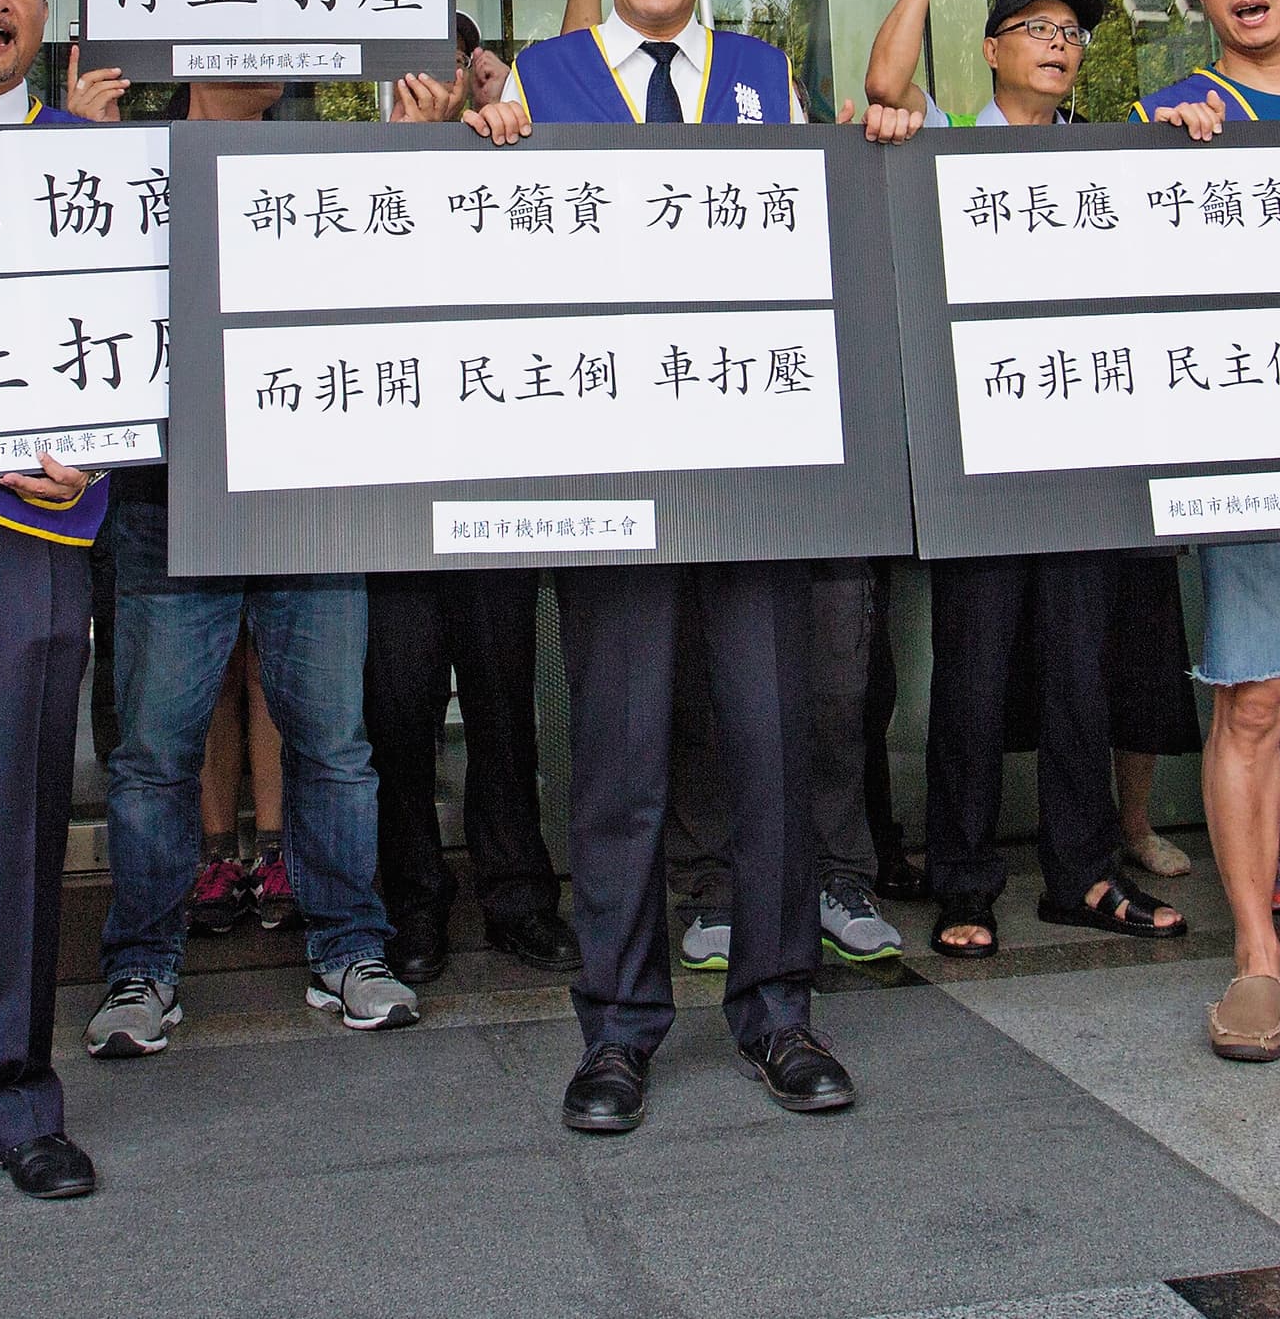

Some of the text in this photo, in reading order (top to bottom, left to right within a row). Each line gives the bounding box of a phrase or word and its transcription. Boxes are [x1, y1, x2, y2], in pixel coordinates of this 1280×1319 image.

[187, 52, 346, 70] 桃園市機師職業工會
[450, 515, 638, 540] 桃園市機師職業工會
